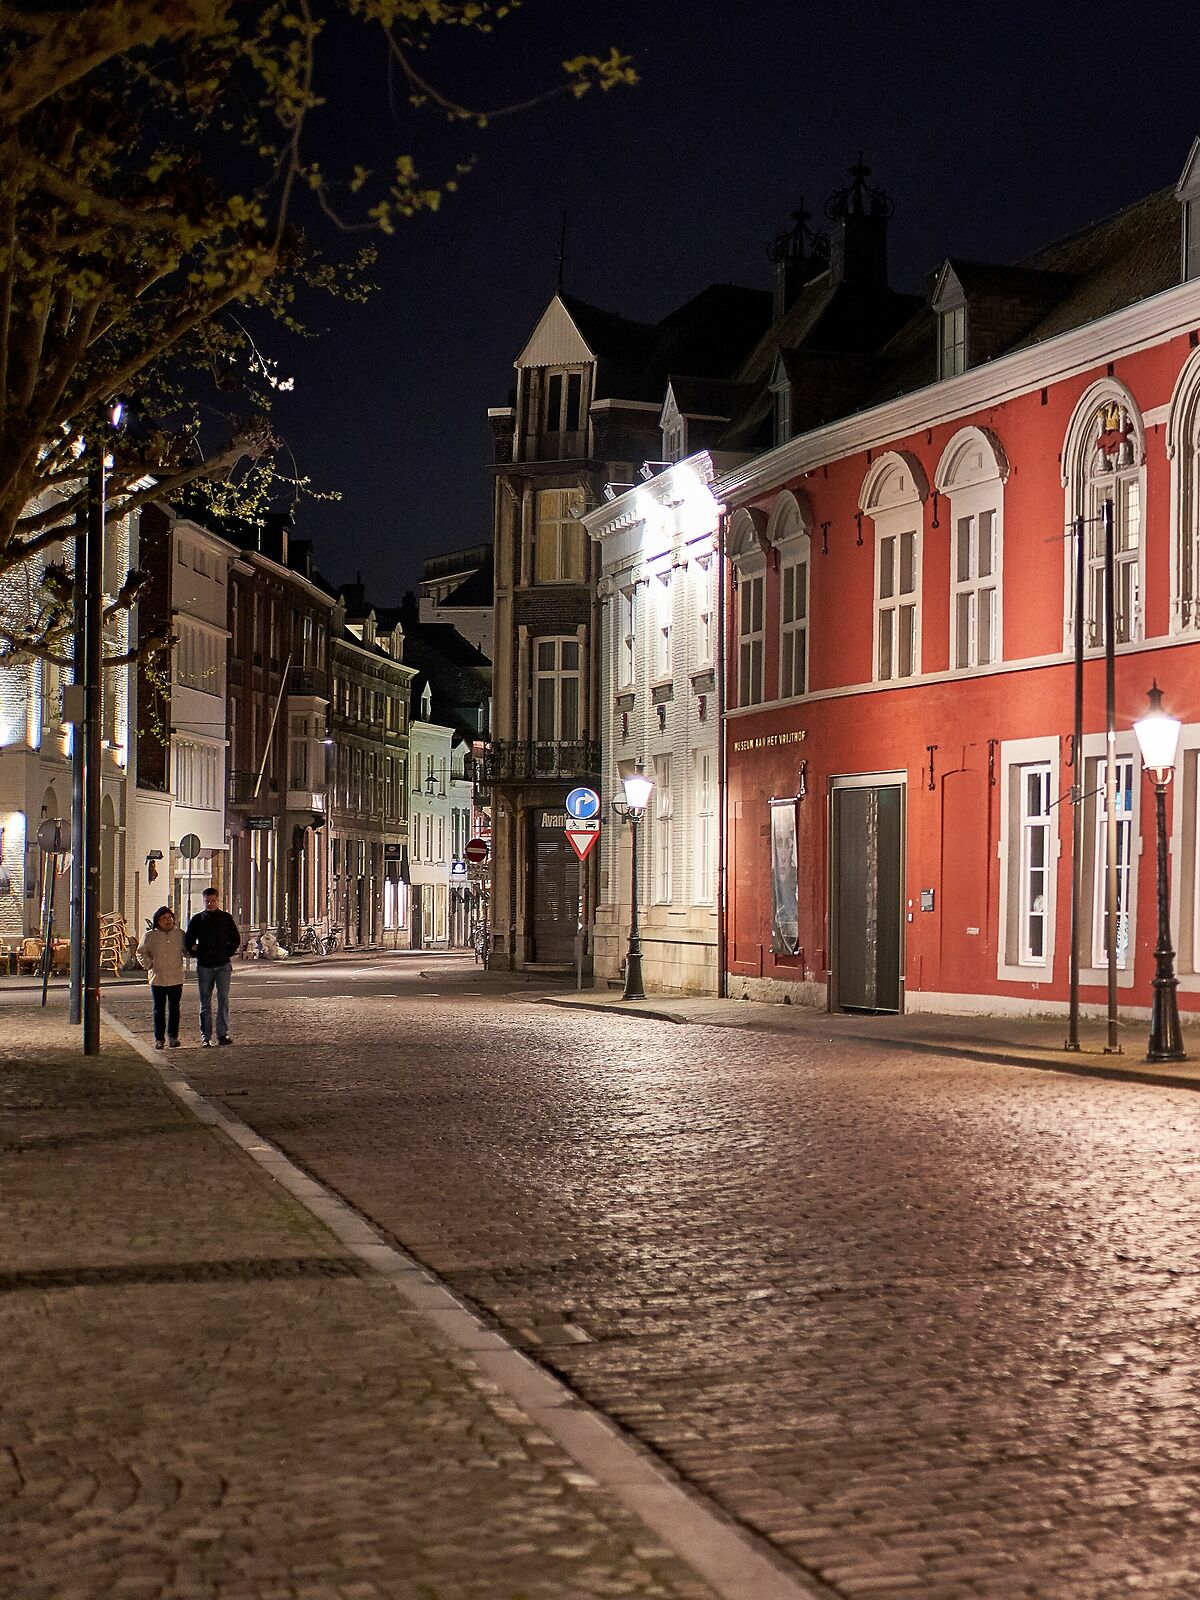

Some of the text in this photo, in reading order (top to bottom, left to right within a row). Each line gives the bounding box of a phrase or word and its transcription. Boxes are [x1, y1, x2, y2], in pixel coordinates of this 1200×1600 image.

[734, 731, 806, 752] MUSEUM AAN HET VRIJTHOF
[541, 813, 571, 827] Avant
